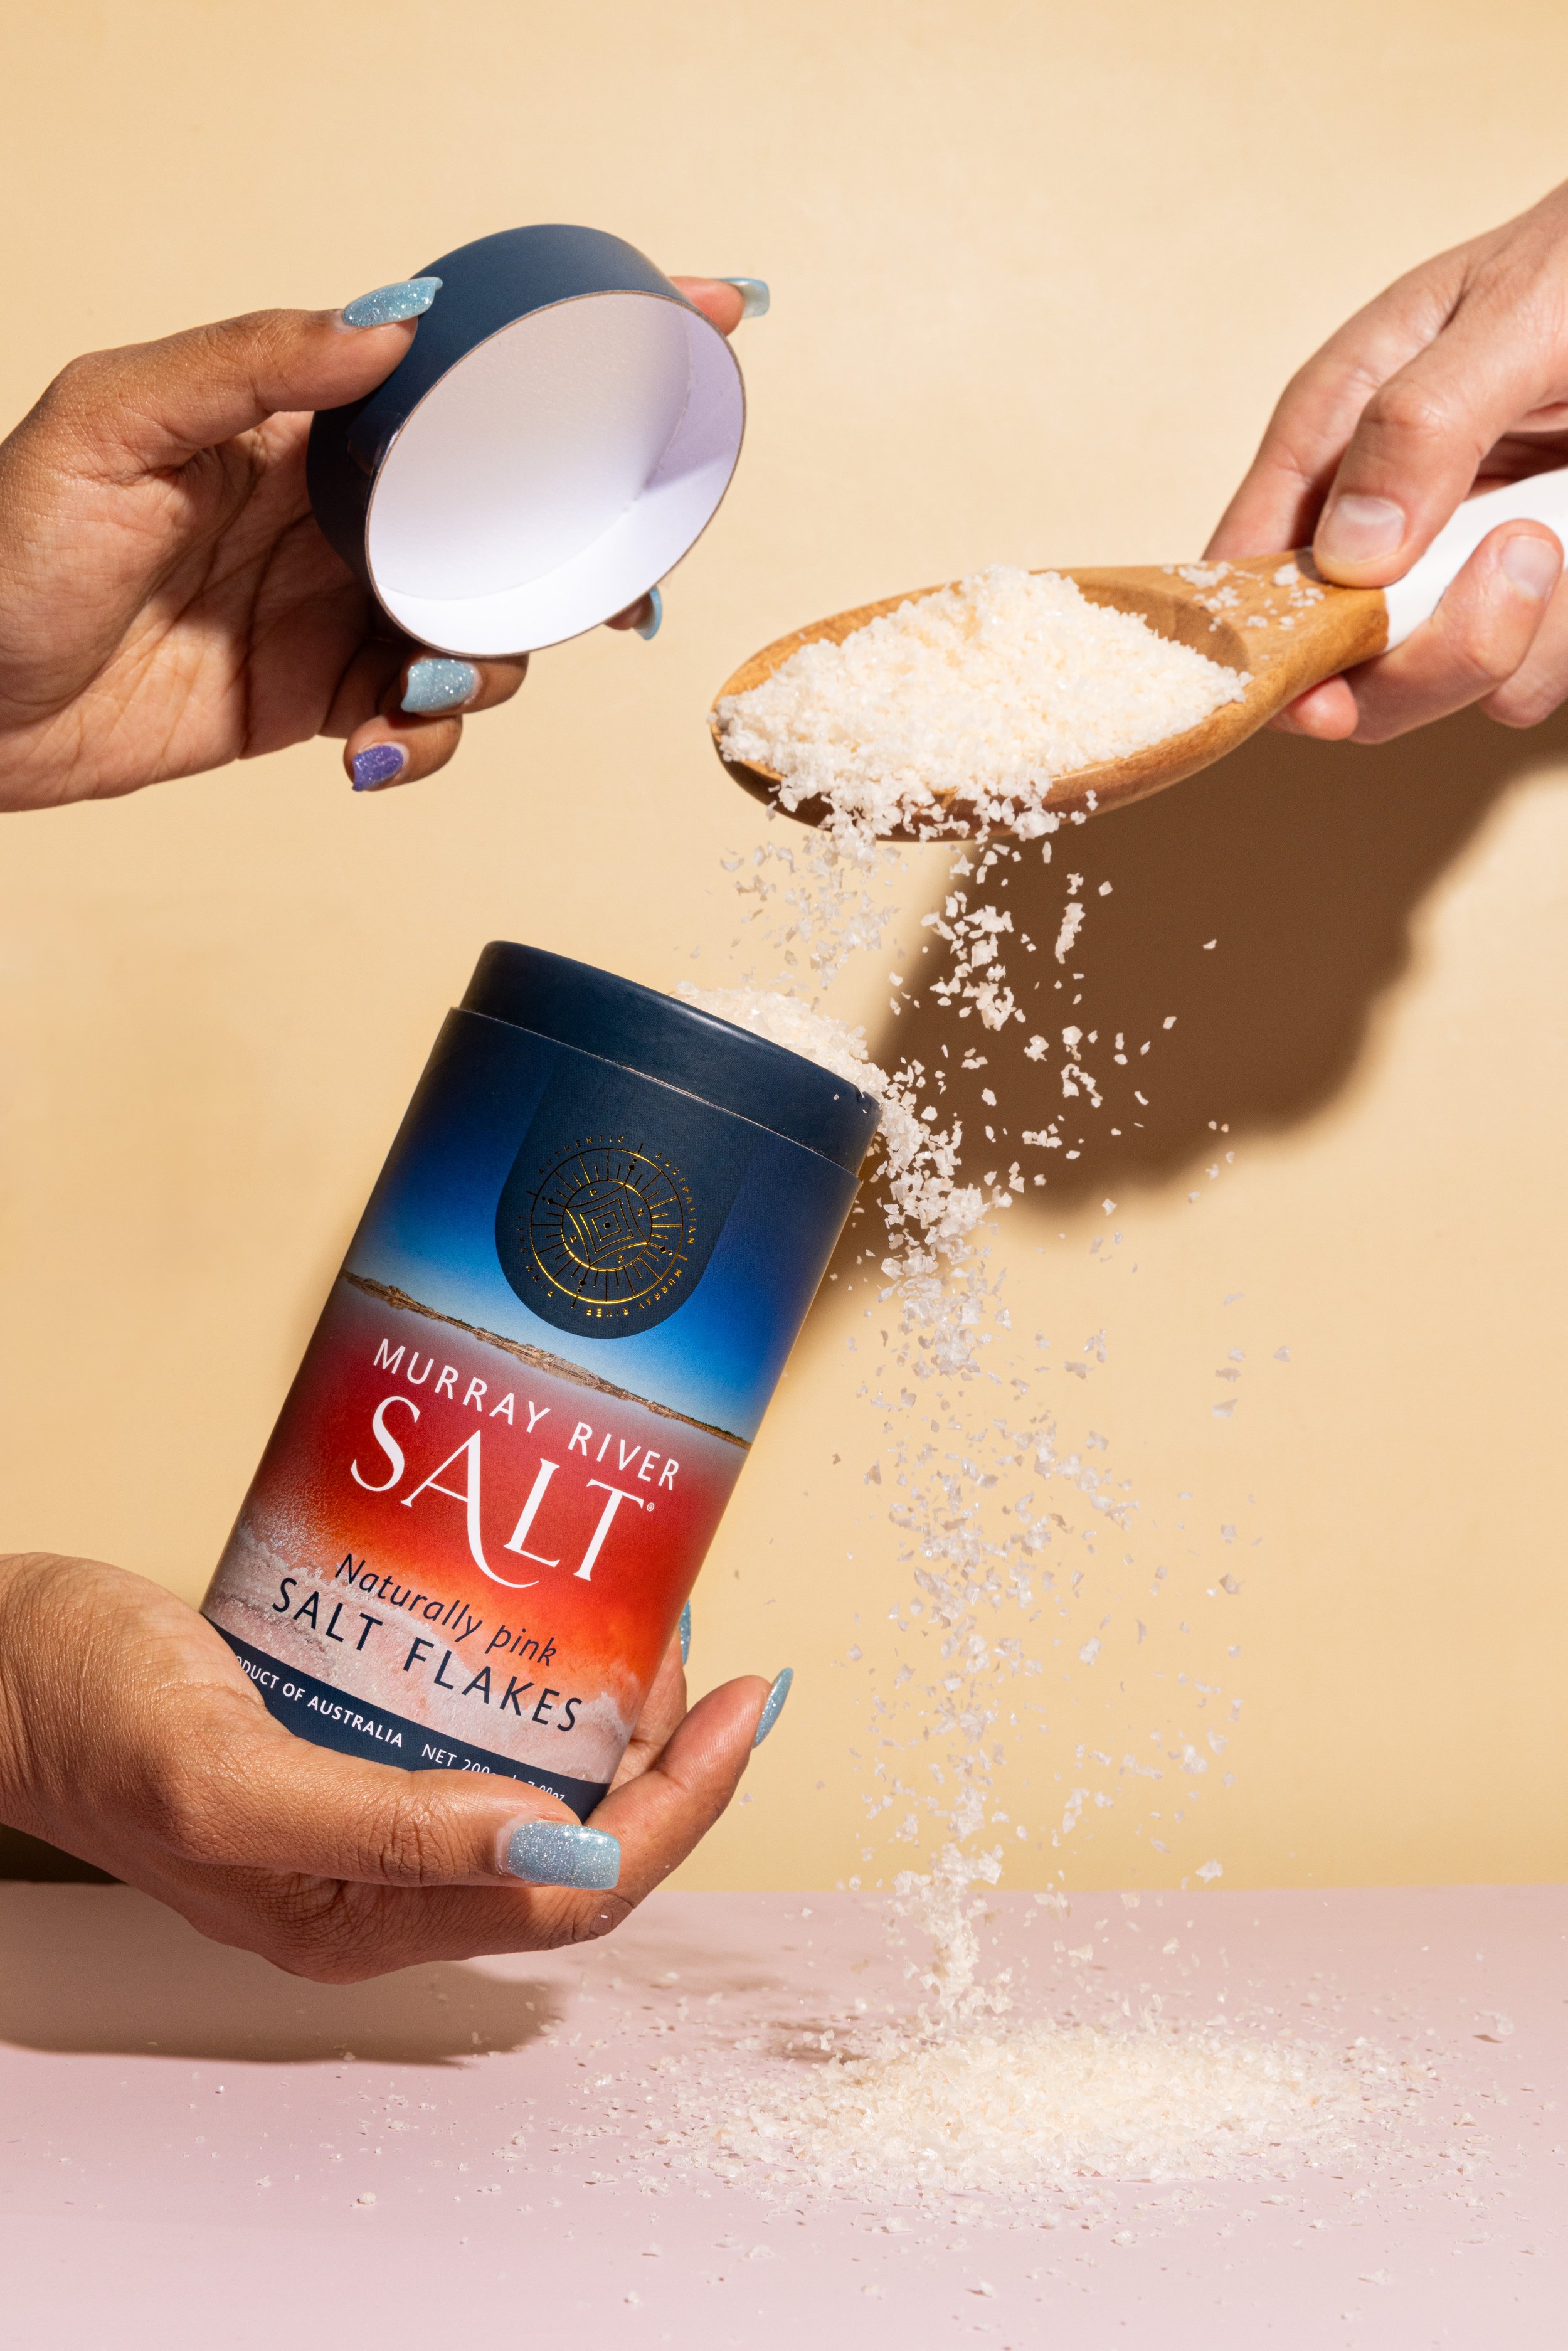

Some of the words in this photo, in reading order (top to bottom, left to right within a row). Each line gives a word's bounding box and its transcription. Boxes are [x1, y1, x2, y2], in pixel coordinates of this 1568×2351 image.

[538, 1134, 625, 1175] AUTHENTIC
[655, 1152, 696, 1244] AUSTRALIAN
[526, 1264, 555, 1297] PINK
[586, 1308, 628, 1317] RIVER
[638, 1268, 682, 1310] MURRAY
[373, 1338, 550, 1433] MURRAY
[568, 1421, 679, 1490] RIVER
[272, 1577, 383, 1651] SALT
[403, 1637, 582, 1732] FLAKES
[335, 1552, 483, 1643] Naturally
[484, 1625, 557, 1667] pink
[236, 1655, 280, 1689] DUCT
[283, 1682, 305, 1701] OF
[307, 1696, 403, 1748] AUSTRALIA
[421, 1744, 457, 1766] NET
[461, 1759, 496, 1775] 200
